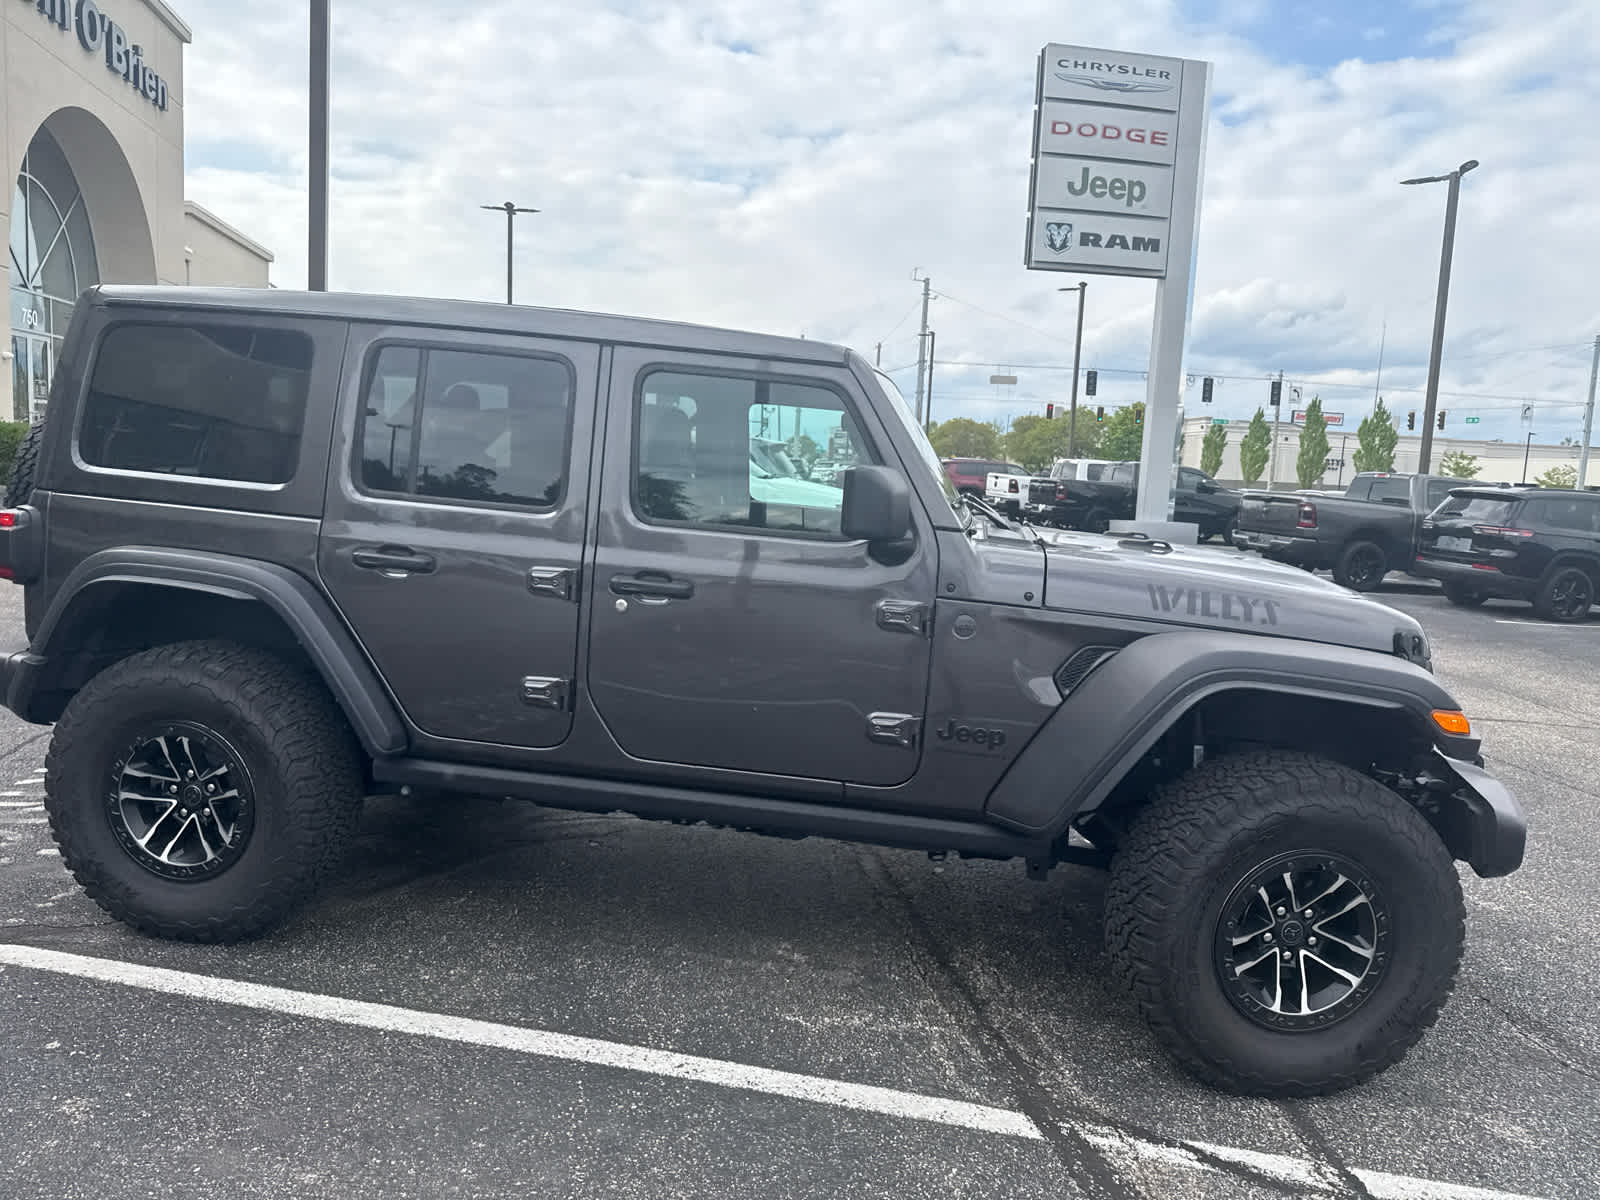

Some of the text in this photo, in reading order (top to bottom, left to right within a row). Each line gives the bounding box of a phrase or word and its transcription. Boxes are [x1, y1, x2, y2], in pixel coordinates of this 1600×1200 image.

[75, 0, 169, 112] O'Brien
[1057, 58, 1172, 81] CHRYSLER
[1051, 120, 1169, 146] DODGE
[1067, 167, 1147, 207] Jeep
[1079, 231, 1161, 253] RAM
[21, 307, 38, 327] 750
[1147, 583, 1281, 626] WILLYS
[936, 718, 1007, 751] Jeep
